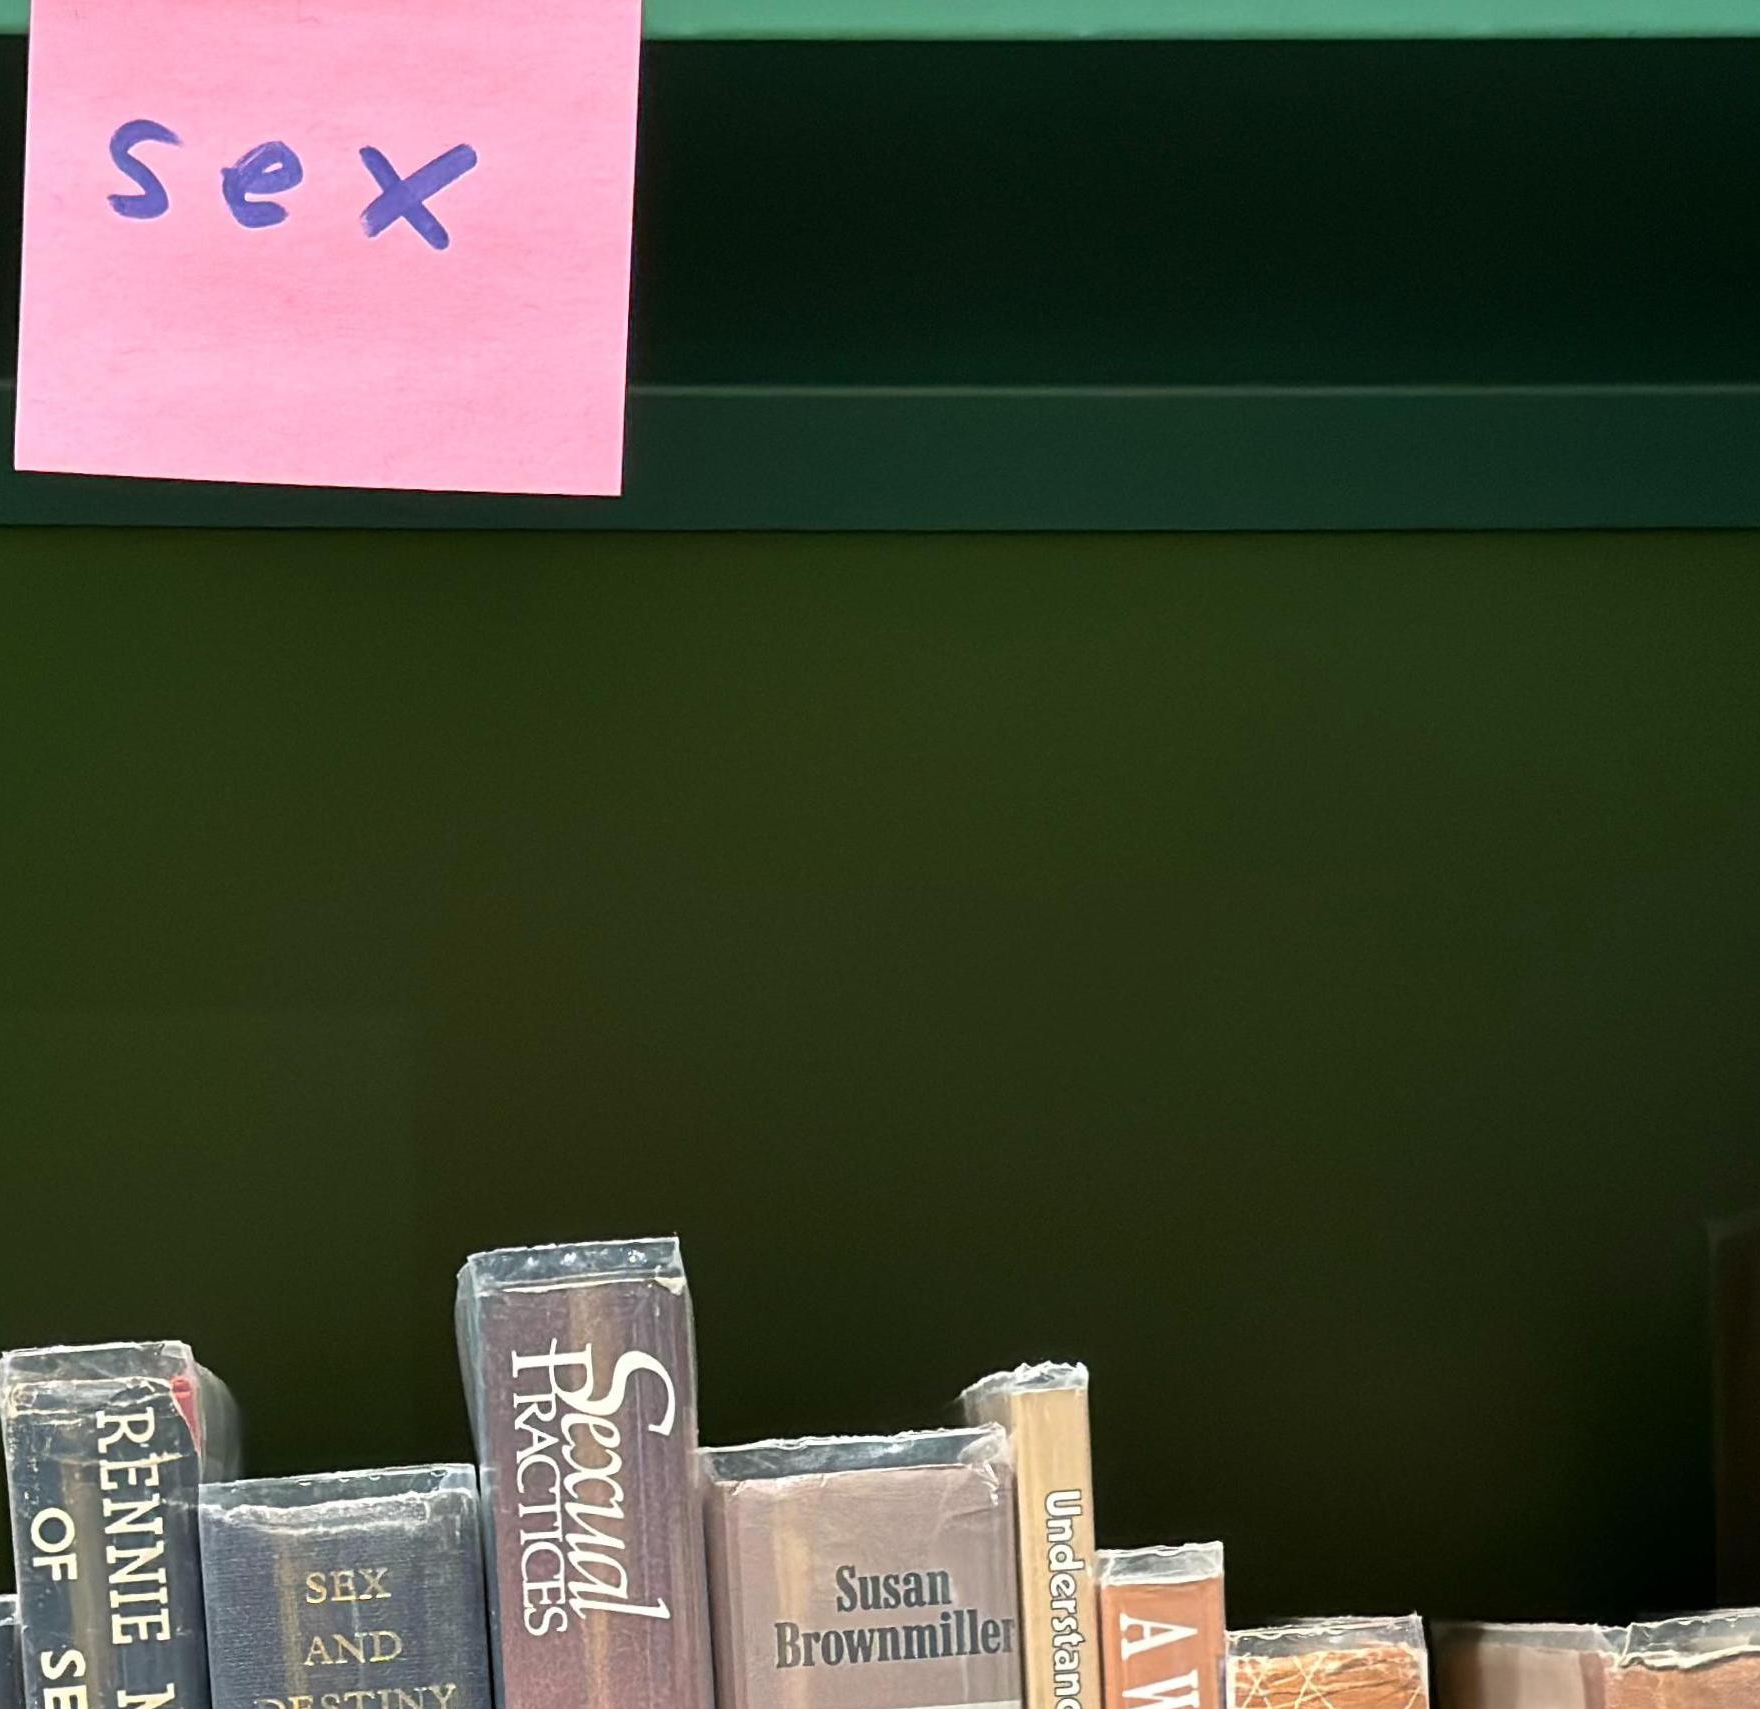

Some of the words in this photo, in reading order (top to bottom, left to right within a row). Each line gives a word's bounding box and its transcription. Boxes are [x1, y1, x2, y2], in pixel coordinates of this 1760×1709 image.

[108, 119, 478, 250] sex
[30, 1506, 77, 1582] OF
[305, 1566, 391, 1604] SEX
[835, 1564, 953, 1613] Susan
[303, 1629, 402, 1667] AND
